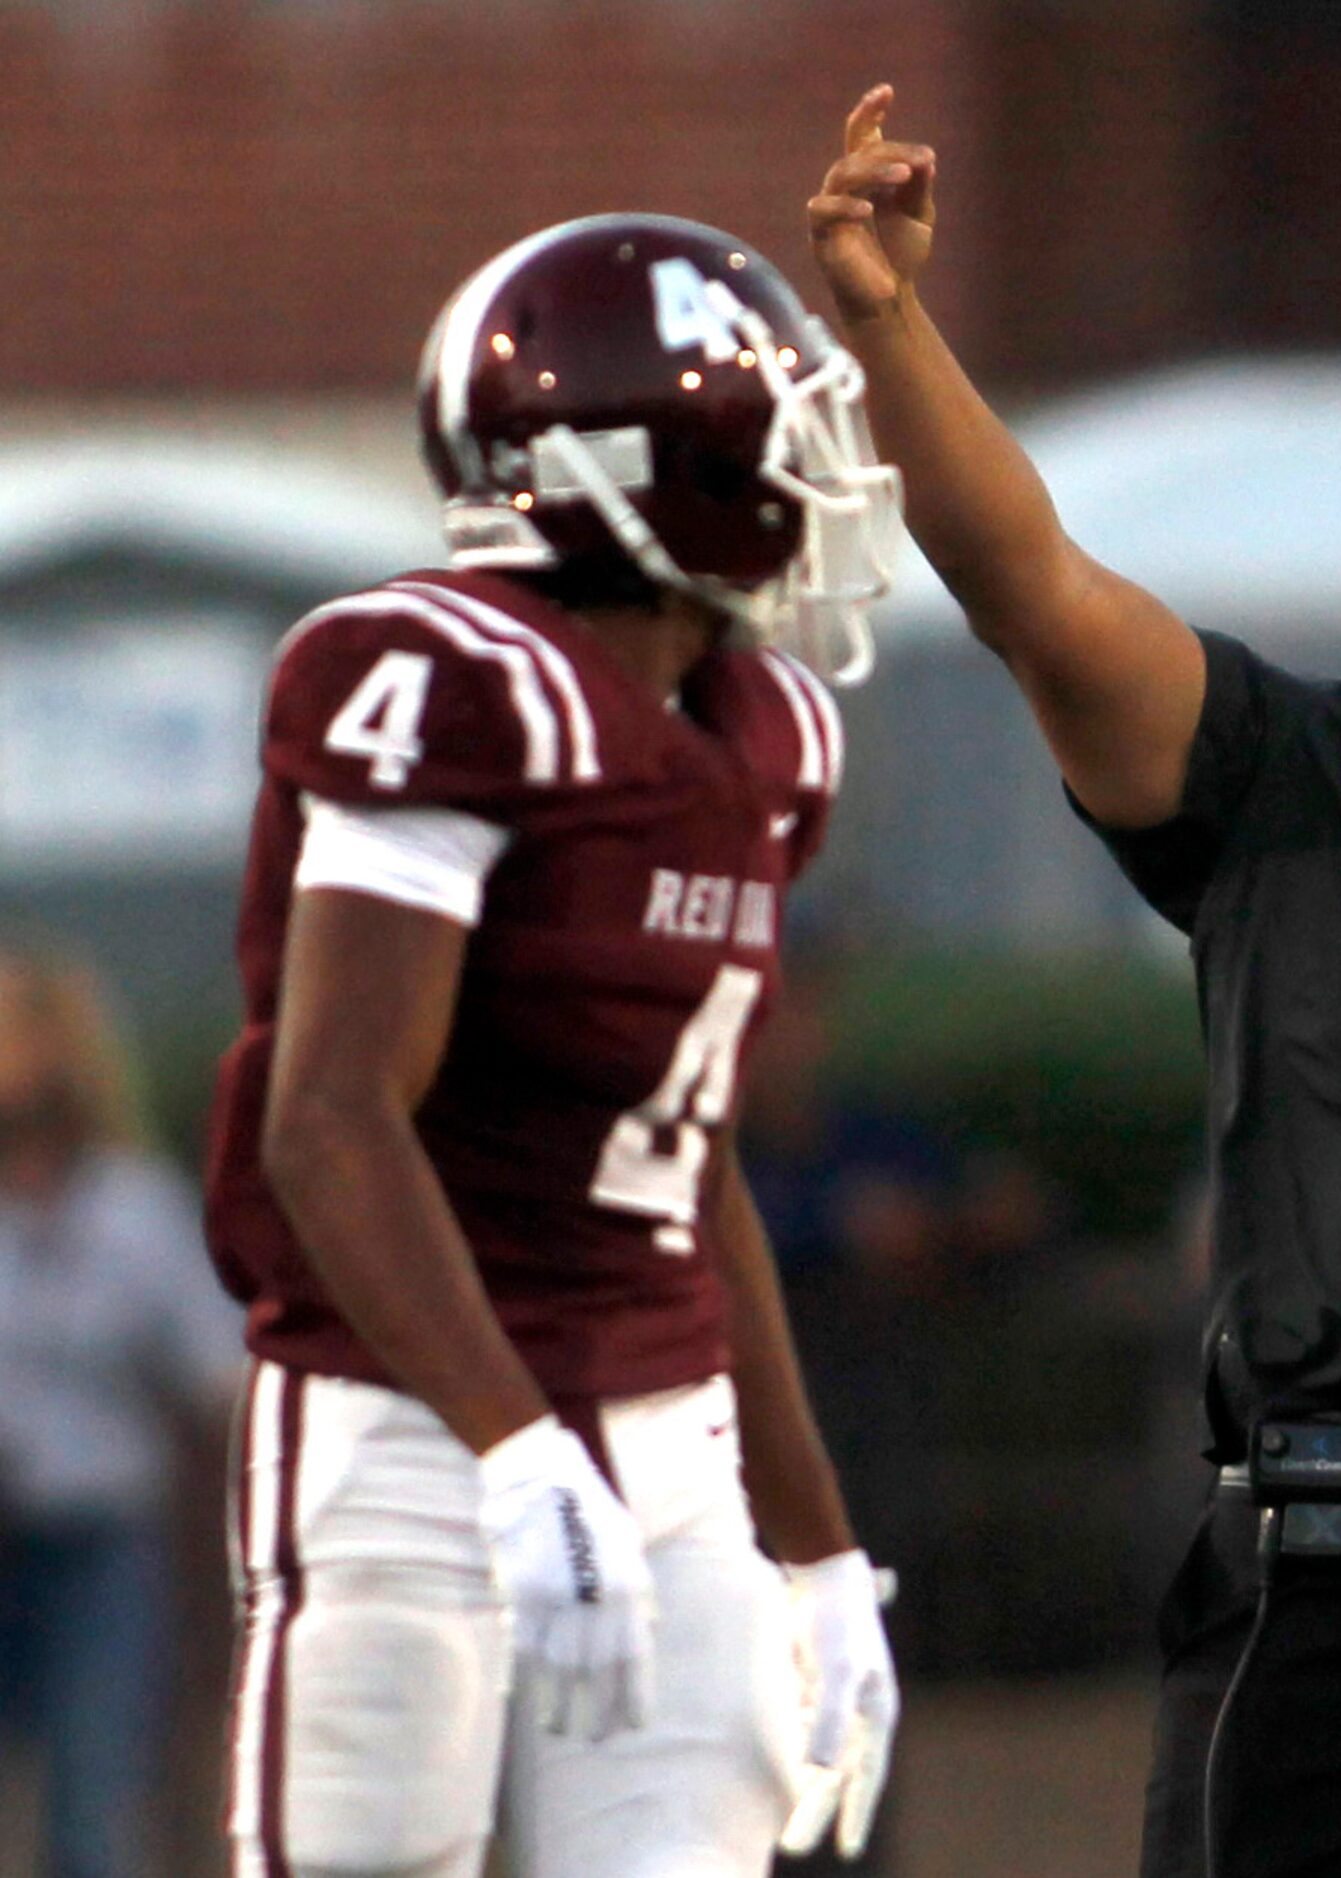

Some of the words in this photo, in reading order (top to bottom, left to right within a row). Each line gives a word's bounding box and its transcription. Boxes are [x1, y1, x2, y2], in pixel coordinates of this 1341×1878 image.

[648, 257, 742, 364] 4
[324, 649, 434, 789] 4
[642, 867, 733, 941] RED
[588, 962, 764, 1255] 4
